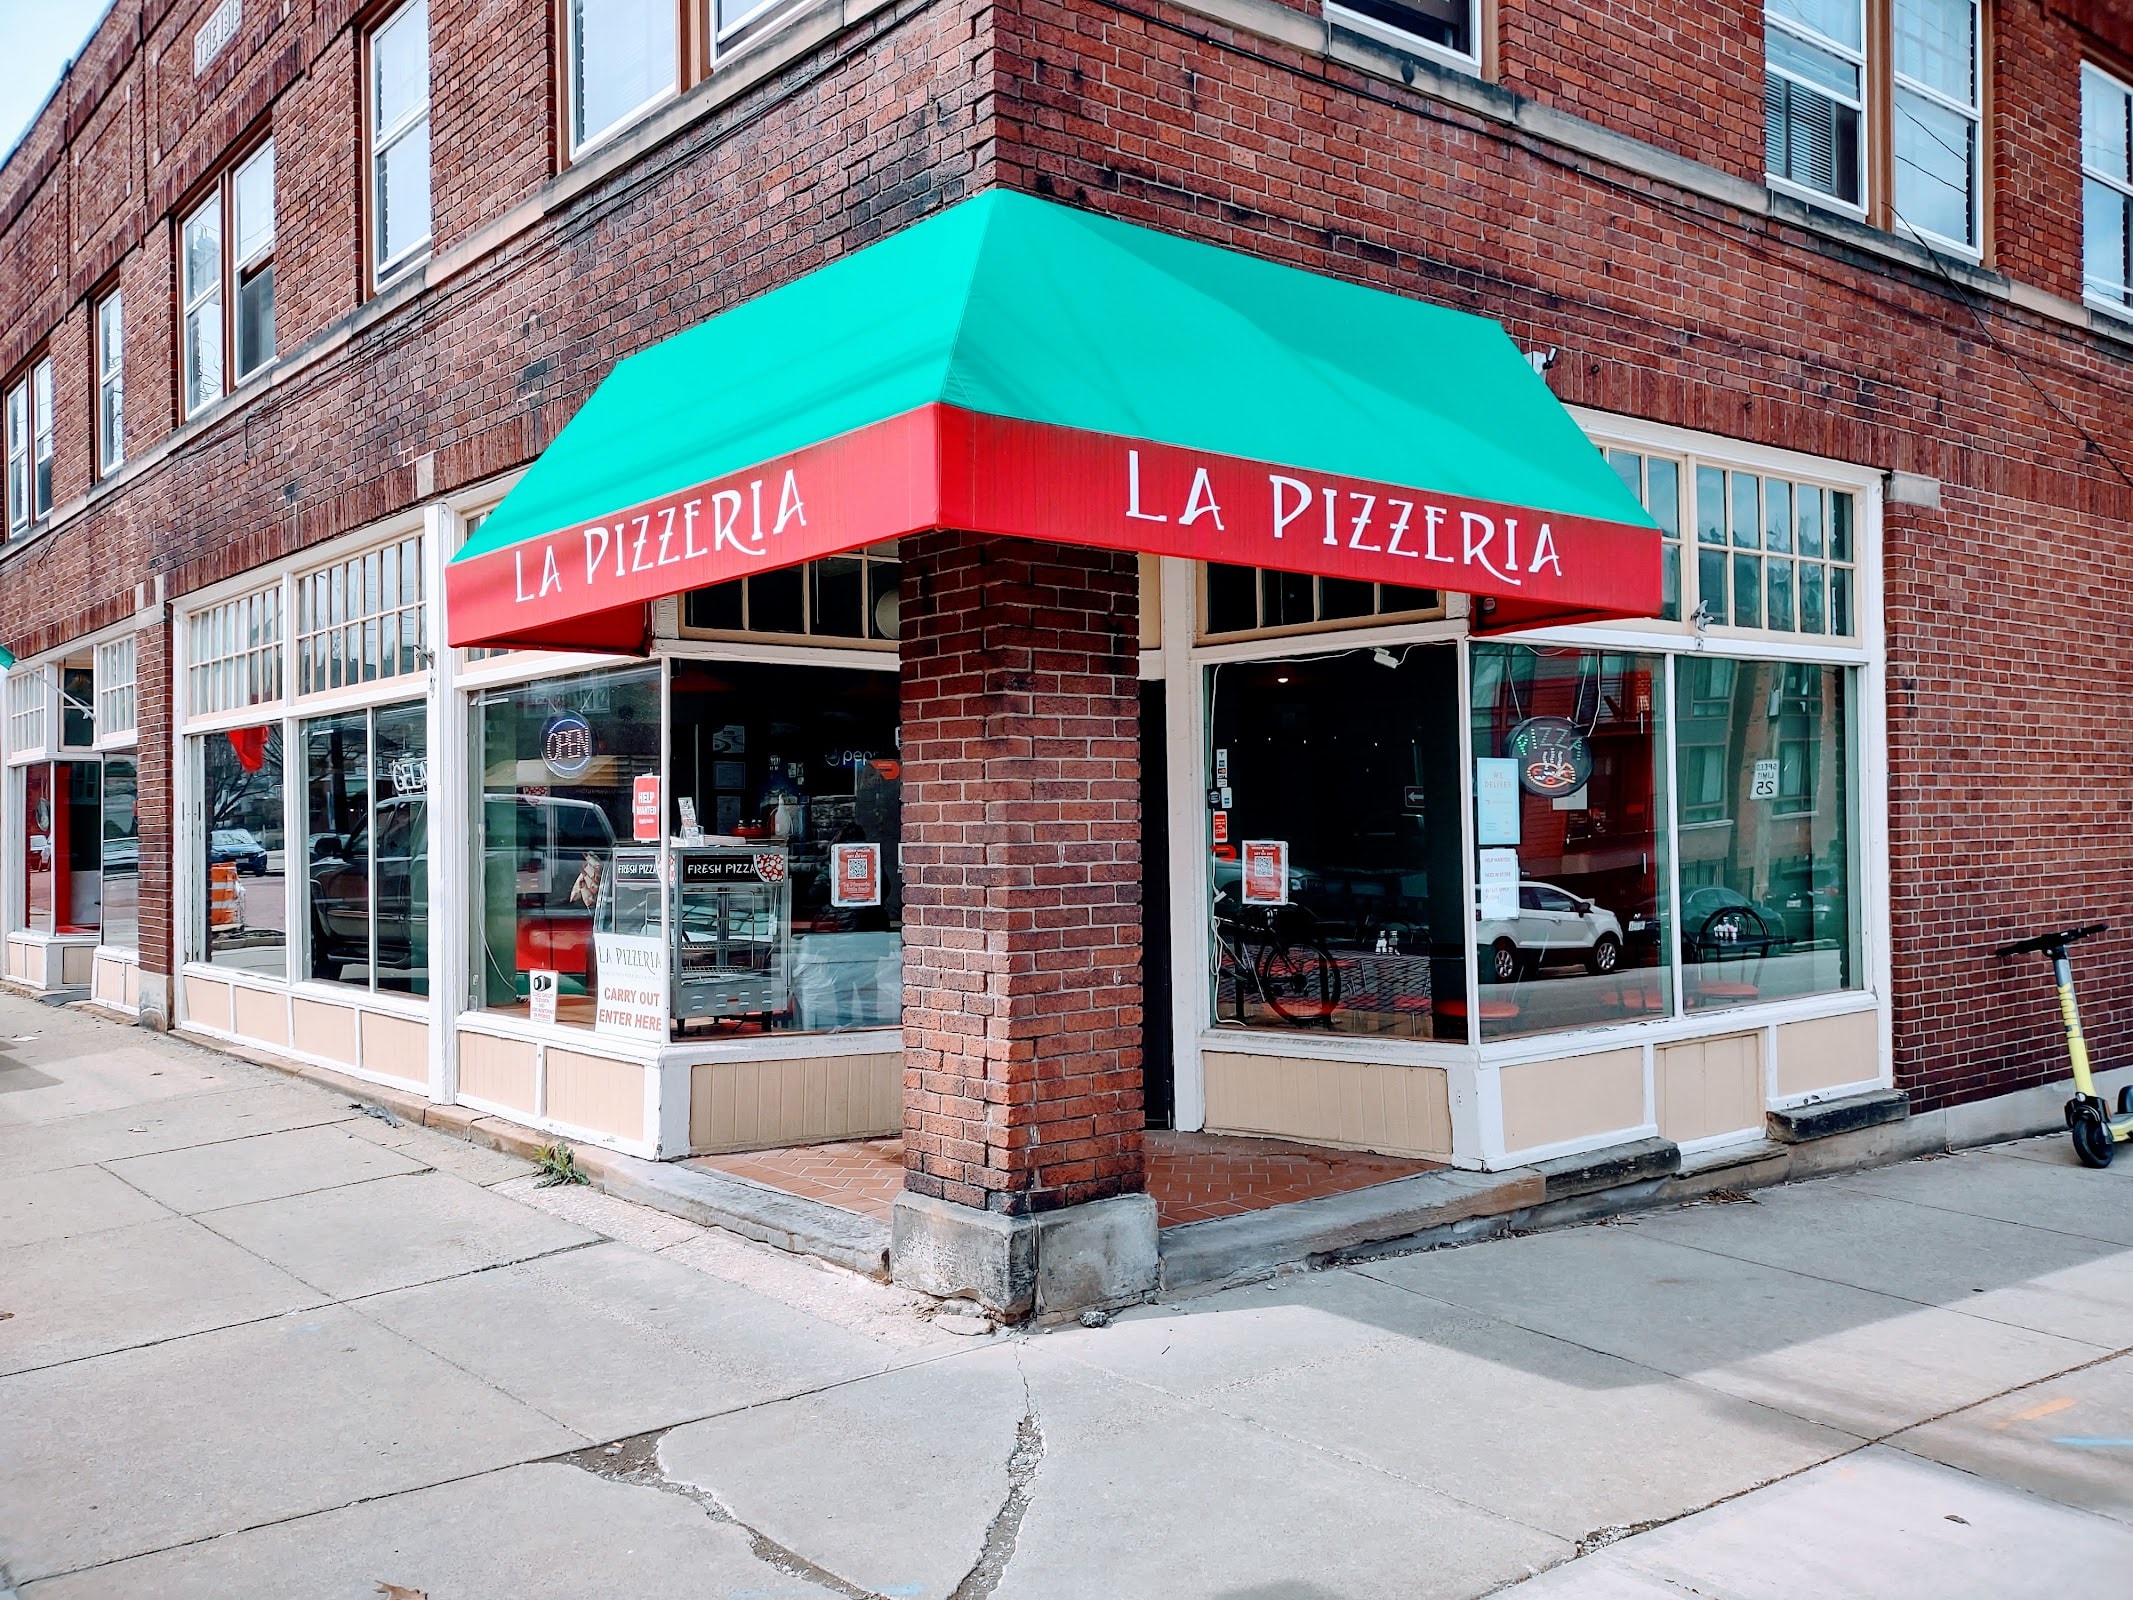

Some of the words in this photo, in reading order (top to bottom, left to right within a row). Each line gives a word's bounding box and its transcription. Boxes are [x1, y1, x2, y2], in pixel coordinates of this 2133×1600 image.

[196, 18, 218, 66] THE
[1126, 450, 1225, 532] LA
[1269, 474, 1563, 586] PIZZERIA
[515, 545, 562, 603] LA
[583, 468, 807, 585] PIZZERIA
[547, 727, 589, 761] OPEN
[1516, 727, 1582, 760] PIZZA
[638, 791, 655, 804] HELP
[618, 864, 638, 874] FRESH
[638, 863, 658, 875] PIZZA
[687, 864, 722, 875] FRESH
[725, 863, 756, 874] PIZZA
[598, 945, 613, 964] LA
[615, 947, 662, 976] PIZZERIA
[604, 986, 637, 1004] CARRY
[639, 991, 660, 1007] OUT
[599, 1008, 632, 1027] ENTER
[634, 1013, 662, 1032] HERE
